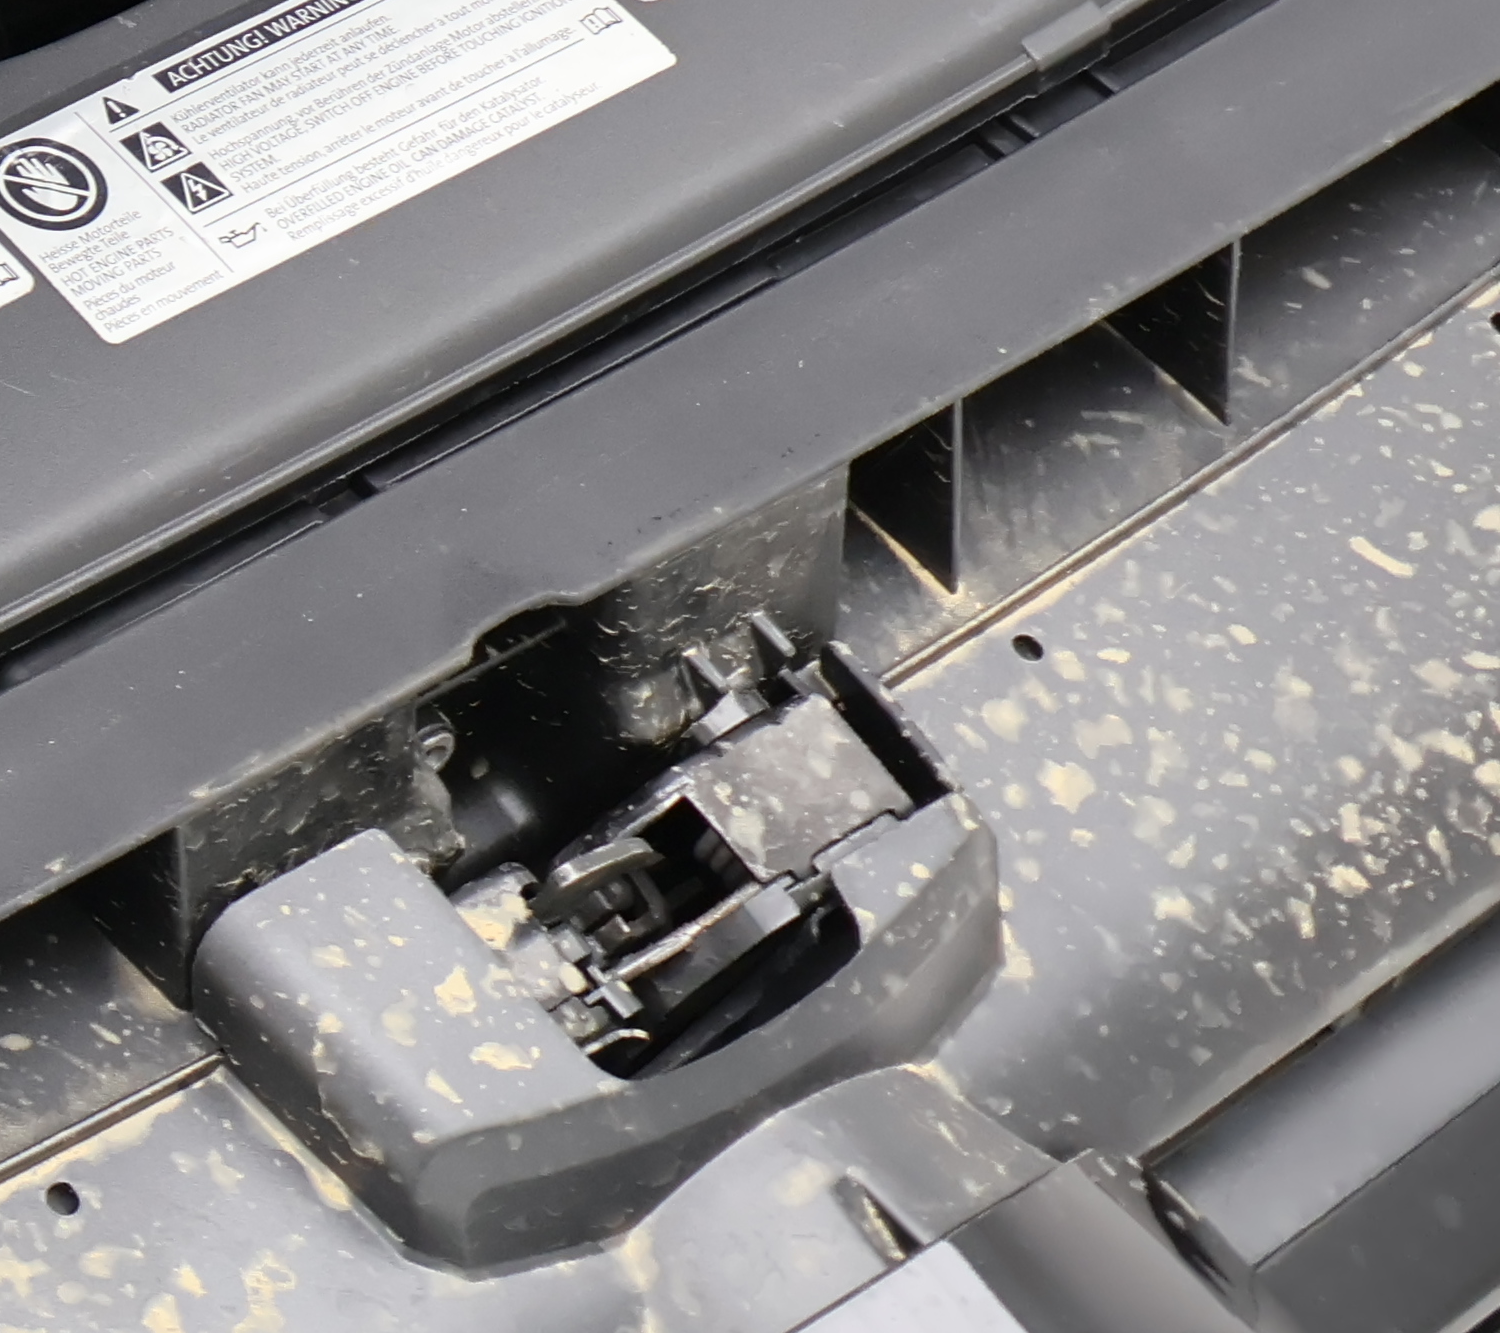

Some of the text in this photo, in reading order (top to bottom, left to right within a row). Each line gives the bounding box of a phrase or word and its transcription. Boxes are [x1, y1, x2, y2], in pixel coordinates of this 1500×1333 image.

[166, 28, 270, 87] ACHTUNG!
[168, 14, 393, 124] Kühlerventilator kann jederzeit anlaufen.
[179, 23, 398, 134] RADIATOR FAN MAY START AT ANY TIME.
[190, 133, 210, 145] Le
[205, 102, 270, 138] ventilateur
[268, 95, 286, 108] de
[283, 70, 338, 101] radiateur
[335, 56, 367, 78] peut
[362, 50, 380, 63] se
[376, 21, 437, 56] déclencher
[442, 4, 472, 22] tout
[217, 148, 254, 171] HIGH
[247, 123, 309, 155] VOLTAGE,
[302, 100, 353, 130] SWITCH
[348, 88, 372, 107] OFF
[370, 67, 419, 96] ENGINE
[414, 47, 462, 75] BEFORE
[456, 17, 522, 52] TOUCHING
[228, 153, 278, 183] SYSTEM.
[37, 210, 142, 264] Heisse Motorteile
[46, 230, 131, 274] Bewegte Teile
[59, 225, 174, 287] HOT ENGINE PARTS
[69, 246, 162, 297] MOVING PARTS
[94, 293, 142, 321] chaudes
